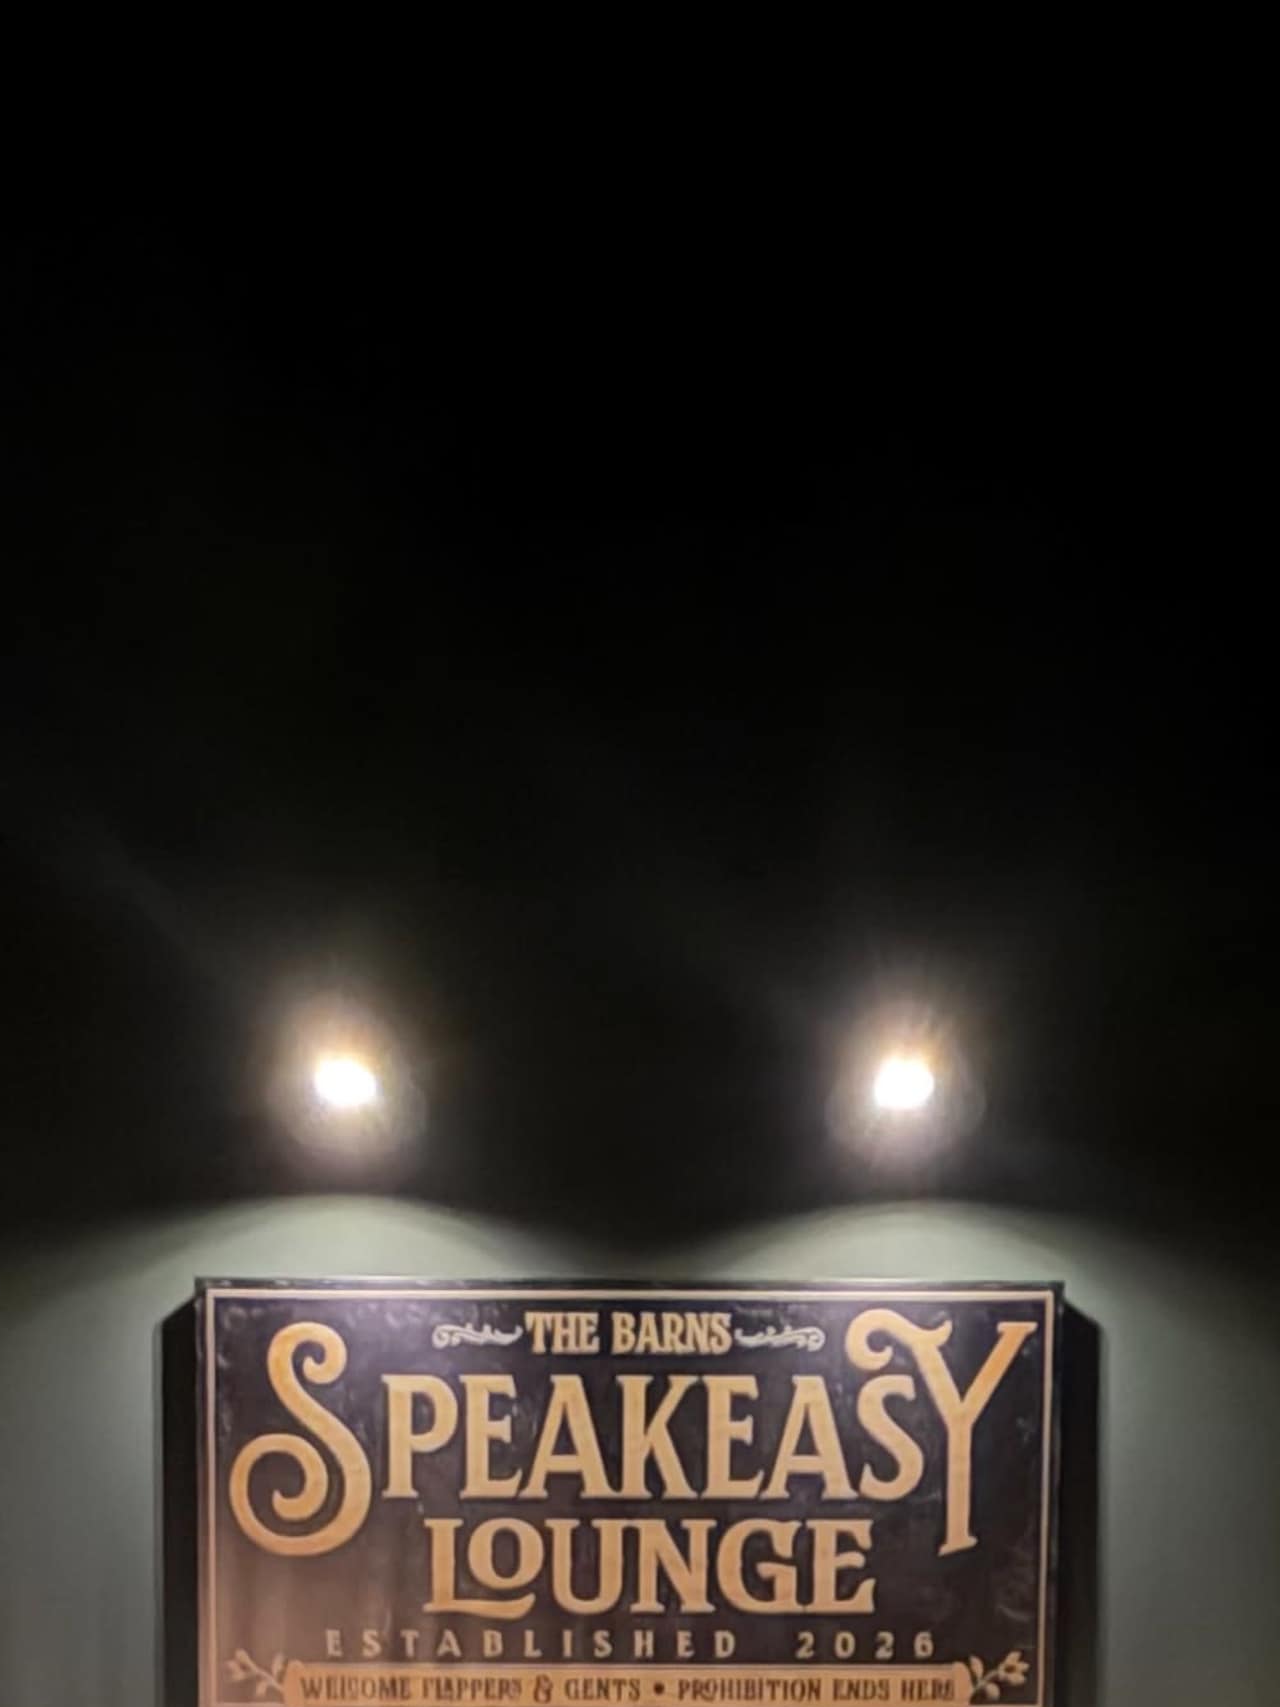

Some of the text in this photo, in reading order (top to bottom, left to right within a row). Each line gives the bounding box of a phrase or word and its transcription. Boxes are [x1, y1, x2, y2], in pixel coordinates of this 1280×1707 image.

[524, 1311, 733, 1355] THE BARNS
[229, 1309, 1037, 1556] SPEAKEASY
[423, 1517, 876, 1620] LOUNGE
[325, 1629, 935, 1660] ESTABLISHED 2026
[300, 1674, 955, 1703] WELCOME FLAPPERS & GENTS PROHIBITION ENDS HERE
